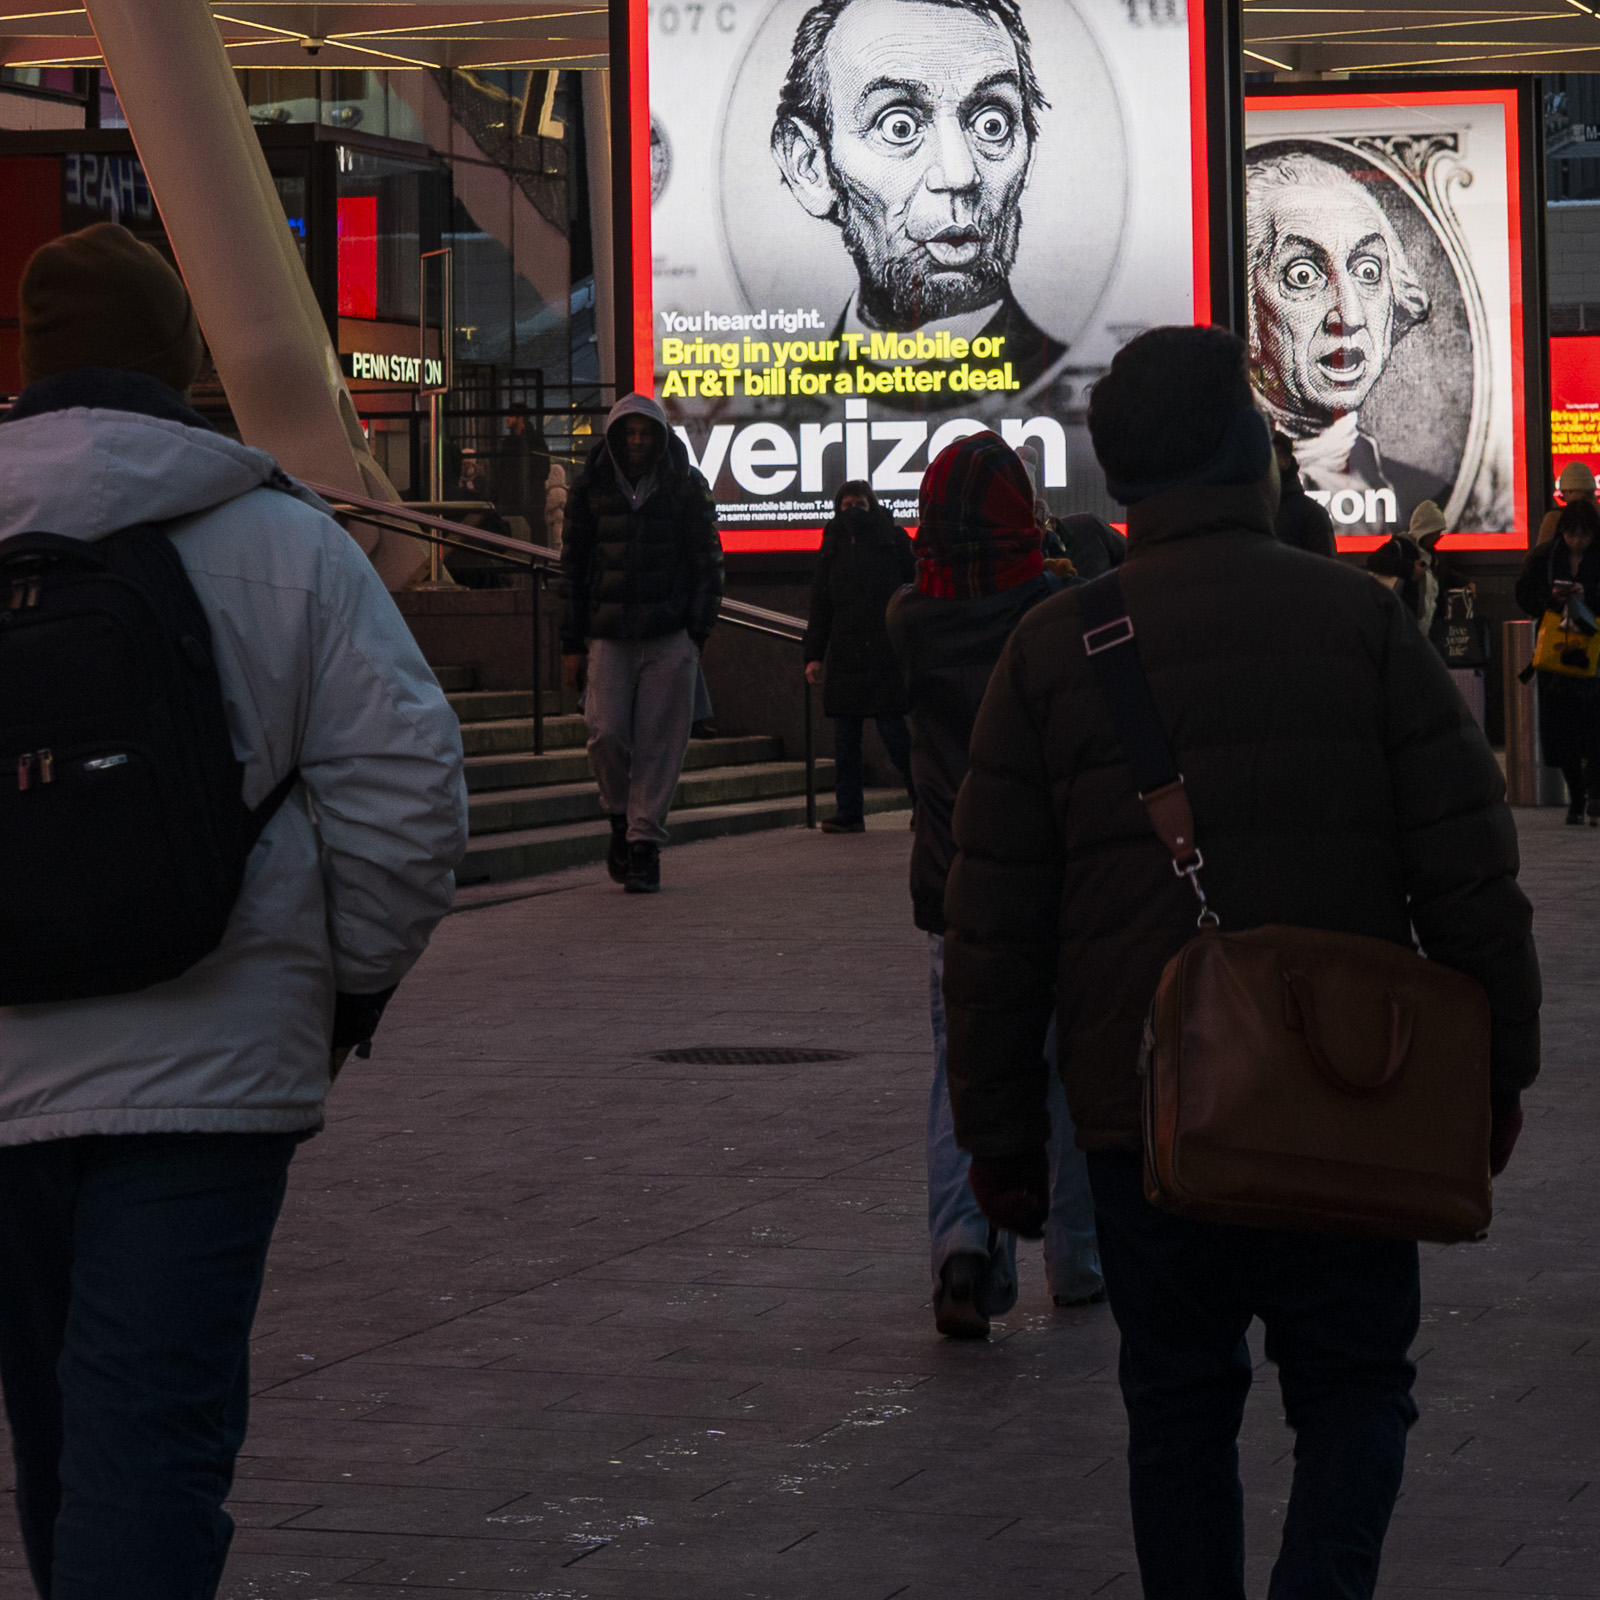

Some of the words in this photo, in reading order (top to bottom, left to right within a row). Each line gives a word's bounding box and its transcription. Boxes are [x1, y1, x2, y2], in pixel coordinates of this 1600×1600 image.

[649, 2, 704, 36] 07
[661, 311, 701, 334] You
[701, 309, 768, 332] heard
[769, 308, 825, 333] right.
[661, 335, 740, 370] Bring
[743, 335, 770, 363] in
[772, 338, 840, 368] your
[841, 330, 970, 362] T-Mobile
[971, 336, 1006, 359] or
[352, 351, 389, 381] PENN
[390, 355, 443, 385] STATON
[661, 369, 741, 399] AT&T
[743, 366, 786, 396] bill
[788, 366, 833, 395] for
[834, 371, 854, 394] a
[856, 364, 947, 393] better
[948, 361, 1020, 391] deal.
[715, 502, 749, 512] nsumer
[749, 501, 779, 512] mobile
[779, 500, 792, 511] bill
[792, 500, 815, 511] from
[727, 512, 750, 522] same
[751, 512, 776, 521] name
[787, 511, 819, 523] person
